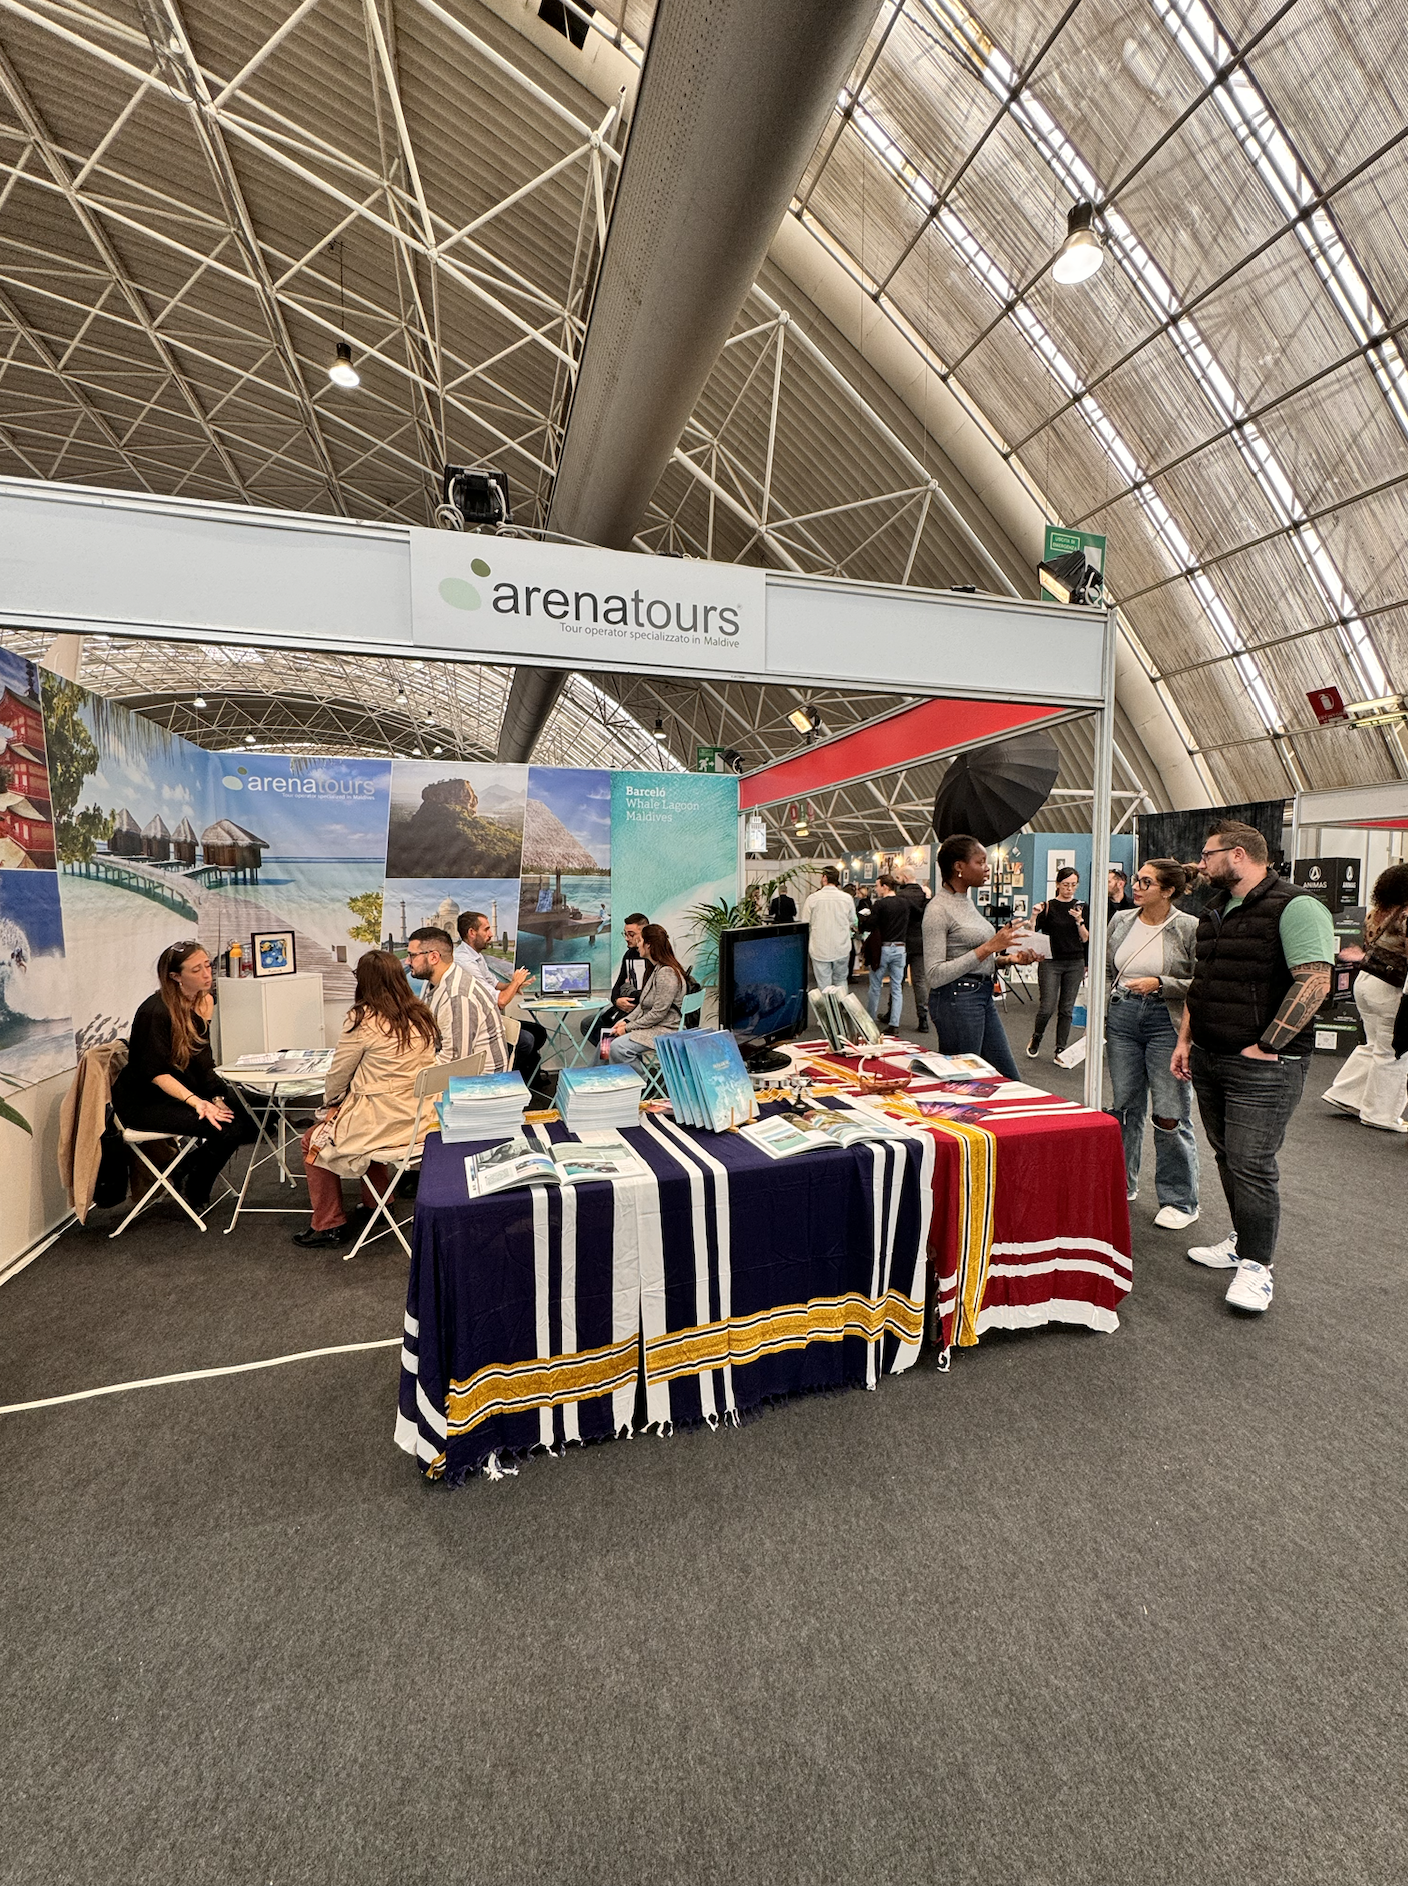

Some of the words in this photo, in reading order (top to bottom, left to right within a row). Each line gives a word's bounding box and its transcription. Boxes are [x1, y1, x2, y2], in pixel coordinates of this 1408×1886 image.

[492, 582, 740, 637] arenatours
[559, 622, 582, 633] Tour
[584, 626, 627, 637] operator
[630, 630, 690, 644] specializzato
[692, 635, 701, 644] in
[704, 636, 740, 648] Maldive
[247, 776, 375, 795] arenatours
[626, 786, 666, 797] Barceló
[626, 798, 660, 809] Whale
[662, 800, 700, 812] Lagoon
[626, 811, 673, 822] Maldives
[1261, 1283, 1272, 1296] N
